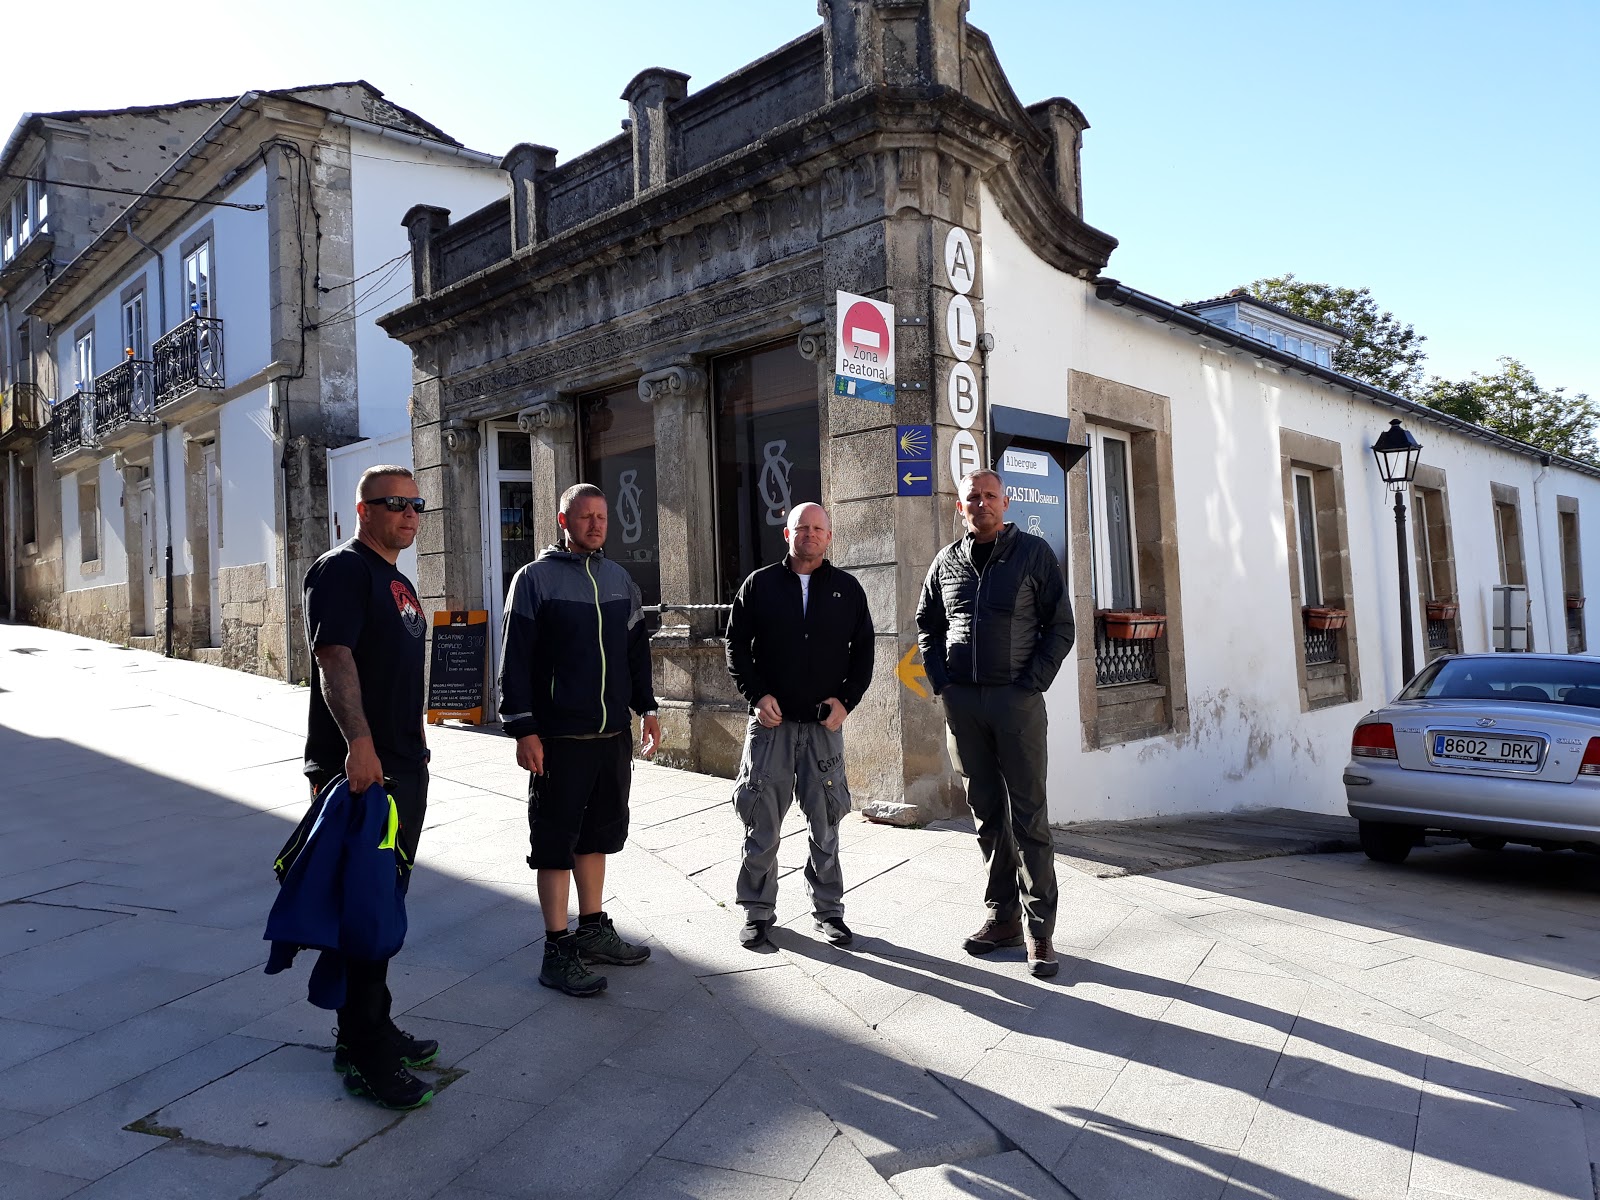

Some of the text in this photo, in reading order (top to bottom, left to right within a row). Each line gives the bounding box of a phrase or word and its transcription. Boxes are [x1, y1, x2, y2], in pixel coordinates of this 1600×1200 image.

[853, 345, 878, 363] Zona
[842, 358, 889, 380] Peatonal
[1005, 455, 1038, 470] Albergue
[1445, 738, 1533, 760] 8602 DRK
